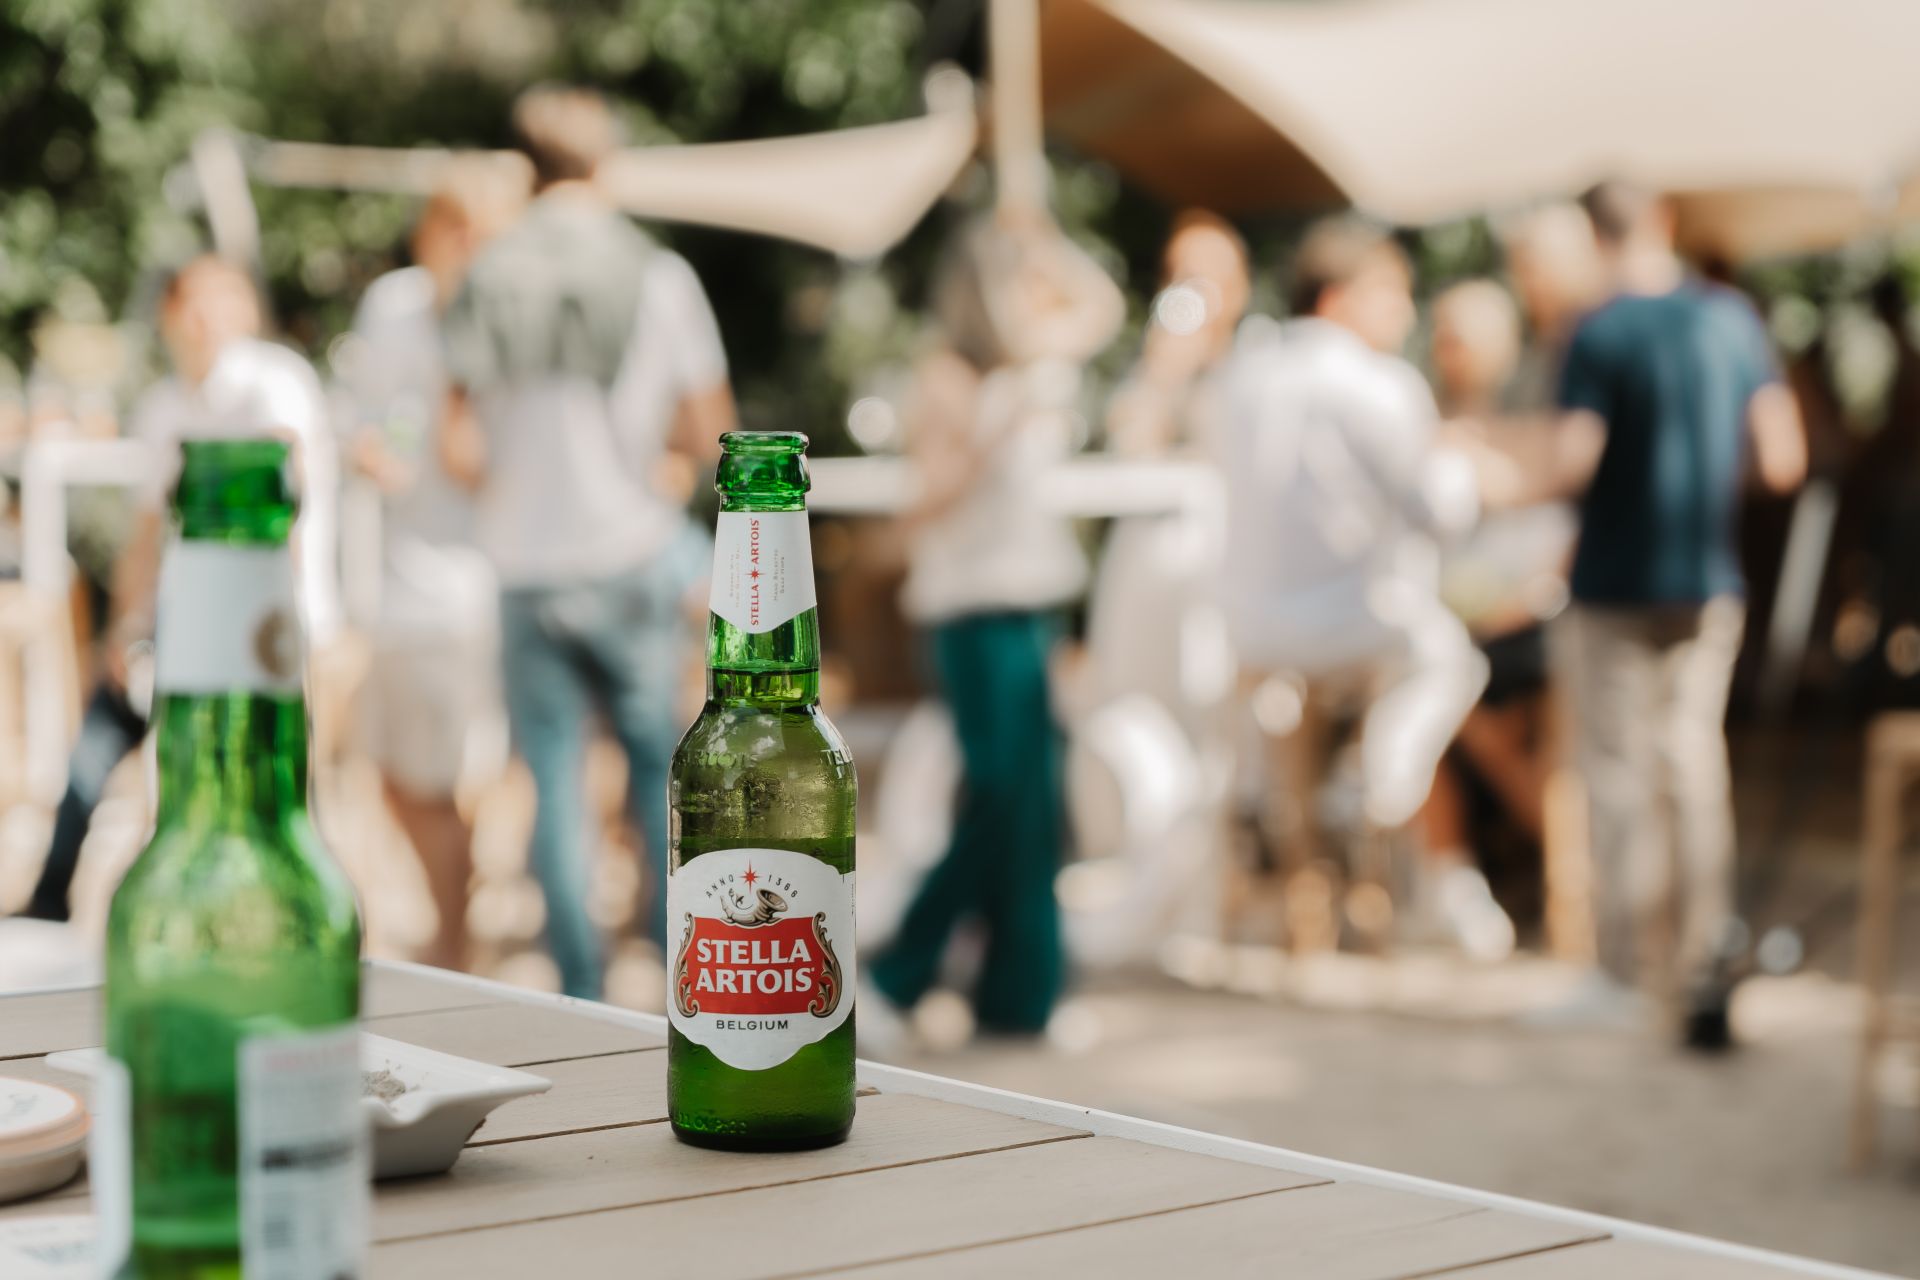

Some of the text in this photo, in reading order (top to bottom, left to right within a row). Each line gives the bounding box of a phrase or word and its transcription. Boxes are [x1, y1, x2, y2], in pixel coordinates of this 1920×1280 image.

[751, 519, 760, 626] STELLA ARTOIS
[705, 874, 798, 899] ANNO 1366
[697, 938, 812, 965] STELLA
[696, 967, 813, 994] ARTOIS
[716, 1019, 789, 1030] BELGIUM
